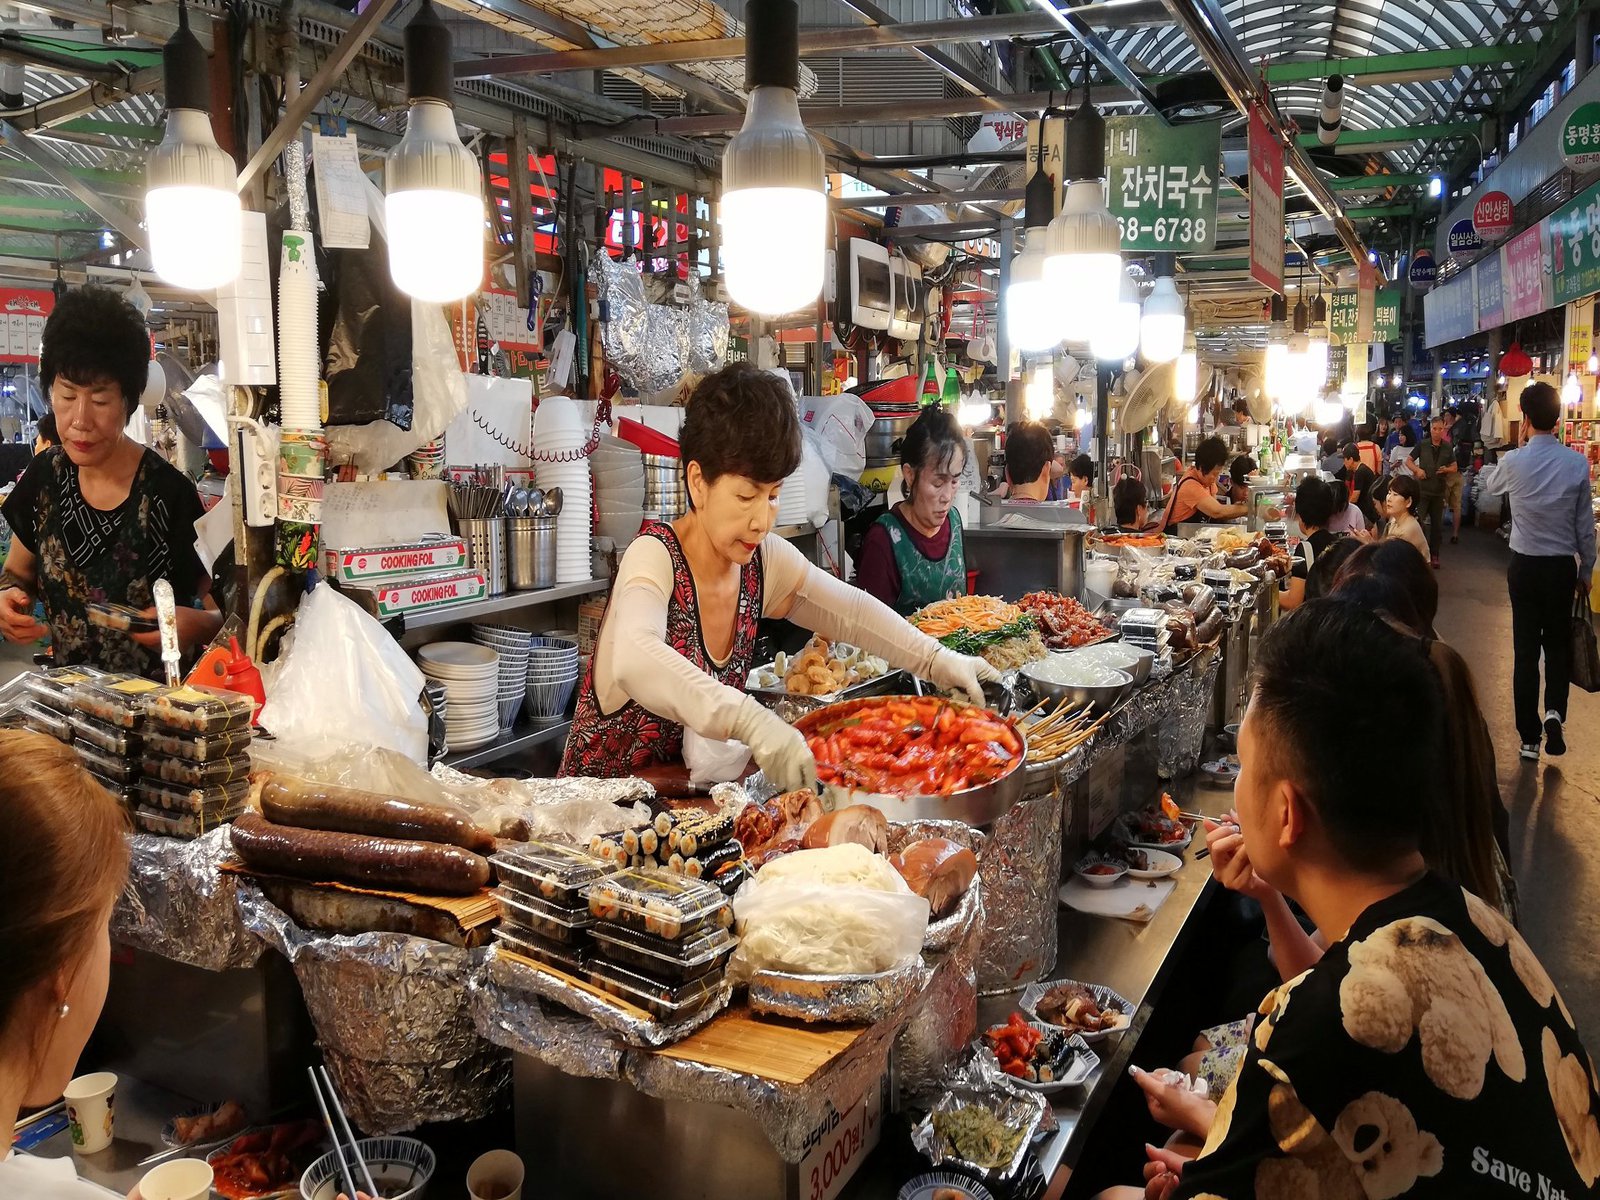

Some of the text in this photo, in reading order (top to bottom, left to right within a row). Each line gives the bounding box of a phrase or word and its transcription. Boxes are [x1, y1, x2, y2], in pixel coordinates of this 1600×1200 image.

[1121, 164, 1213, 209] 잔치국수
[1476, 199, 1510, 224] 신안상회
[1471, 1145, 1532, 1193] Save
